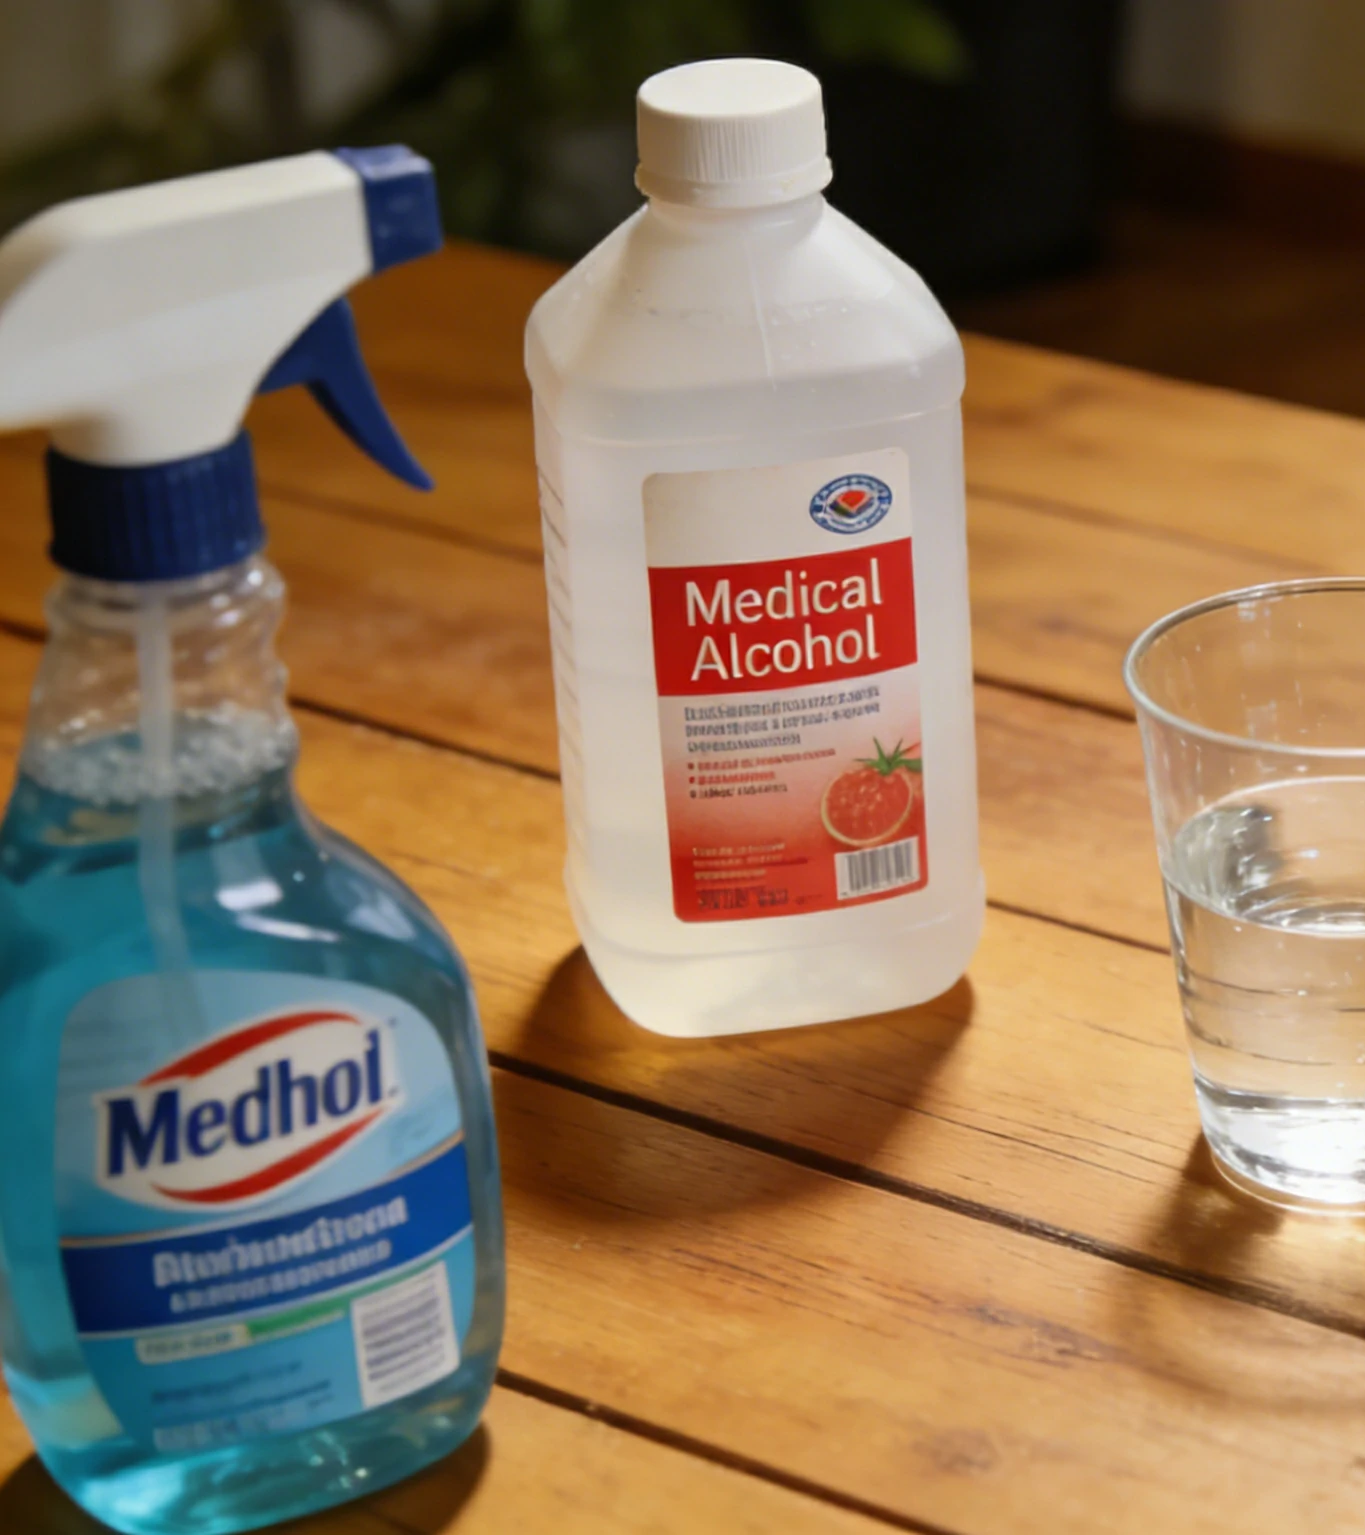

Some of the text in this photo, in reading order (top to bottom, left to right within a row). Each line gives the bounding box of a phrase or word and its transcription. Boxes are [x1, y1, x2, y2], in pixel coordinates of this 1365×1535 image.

[684, 557, 883, 627] Medical
[690, 614, 881, 681] Alcohol
[105, 1027, 382, 1179] Medhol
